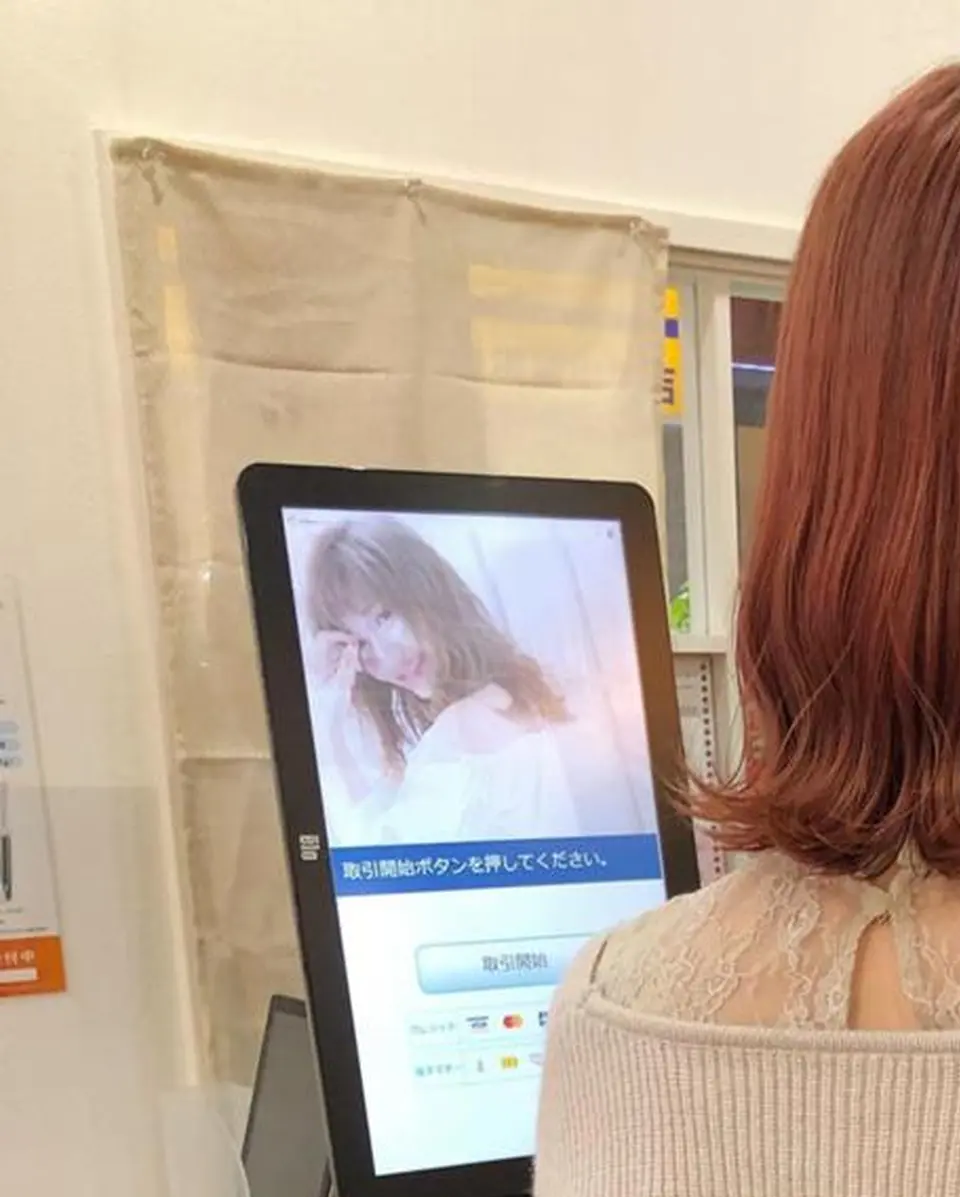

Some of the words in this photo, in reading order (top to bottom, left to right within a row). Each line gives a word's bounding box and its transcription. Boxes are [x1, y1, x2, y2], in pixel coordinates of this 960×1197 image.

[342, 851, 608, 879] 取引開始ボタンを押してください。
[481, 952, 549, 972] 取引開始
